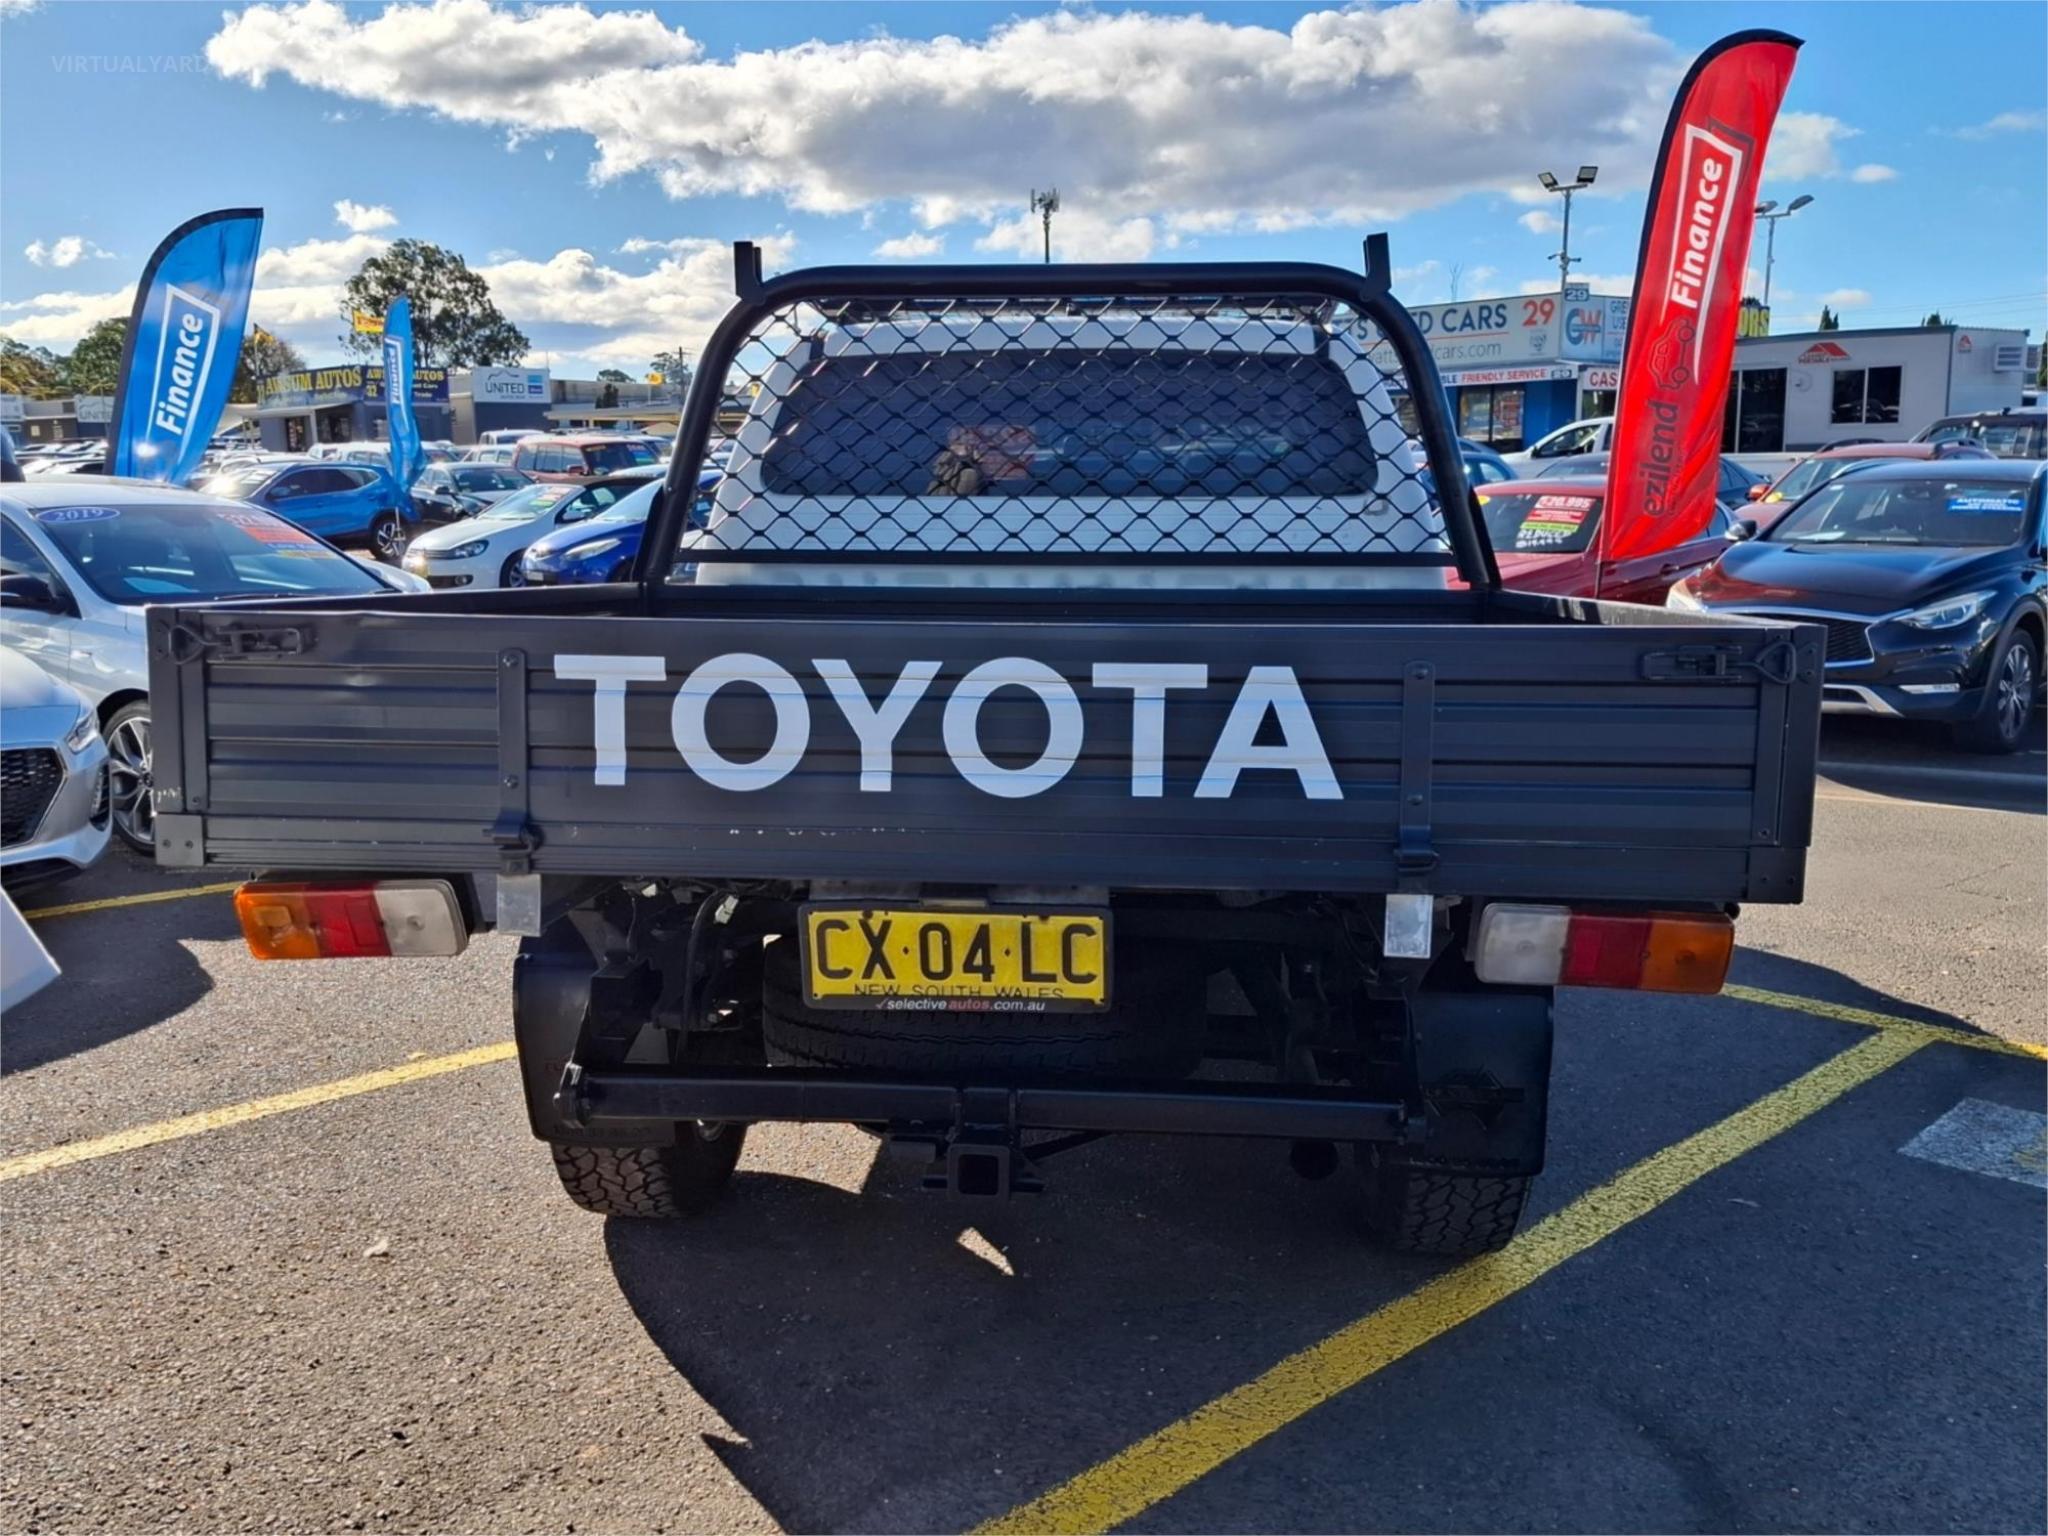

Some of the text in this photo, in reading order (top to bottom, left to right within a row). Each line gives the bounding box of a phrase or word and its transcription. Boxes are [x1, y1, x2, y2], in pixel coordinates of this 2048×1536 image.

[1670, 158, 1723, 309] Finance
[1566, 288, 1587, 300] 29
[1441, 302, 1508, 333] CARS
[1521, 299, 1555, 327] 29
[1738, 306, 1770, 337] ORS
[155, 312, 204, 436] Finance
[316, 365, 363, 391] AUTOS
[1462, 371, 1506, 383] FRIENDLY
[1506, 368, 1548, 380] SERVICE
[1589, 371, 1618, 387] CAS
[486, 381, 525, 394] UNITED
[1640, 398, 1679, 517] ezilend
[54, 506, 104, 522] 2019
[553, 652, 1345, 801] TOYOTA
[853, 983, 1064, 999] NEW SOUTH WALES
